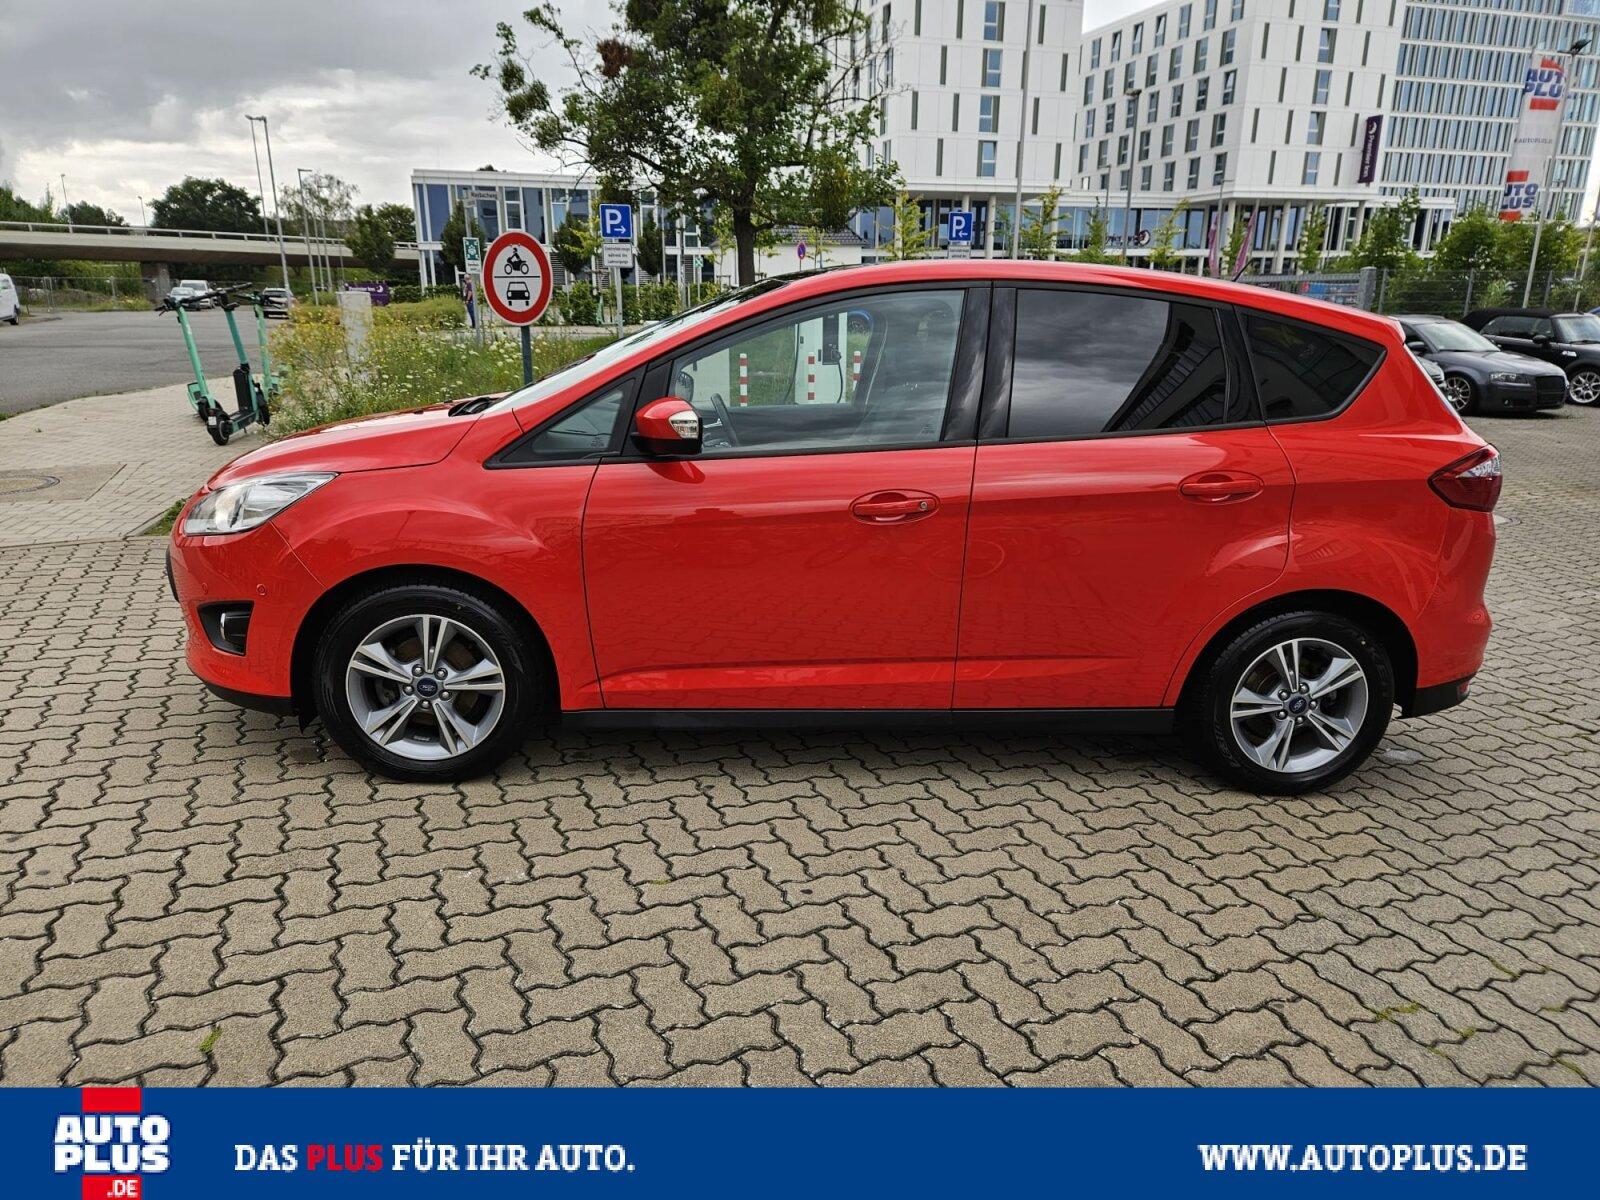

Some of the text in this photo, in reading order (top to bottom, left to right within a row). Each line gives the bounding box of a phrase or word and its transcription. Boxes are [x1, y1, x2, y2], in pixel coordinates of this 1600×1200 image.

[1527, 69, 1564, 83] AUT
[1524, 82, 1563, 97] PLU
[1365, 134, 1374, 164] Premier
[1504, 184, 1538, 196] UTO
[605, 209, 622, 234] P
[952, 215, 966, 238] P
